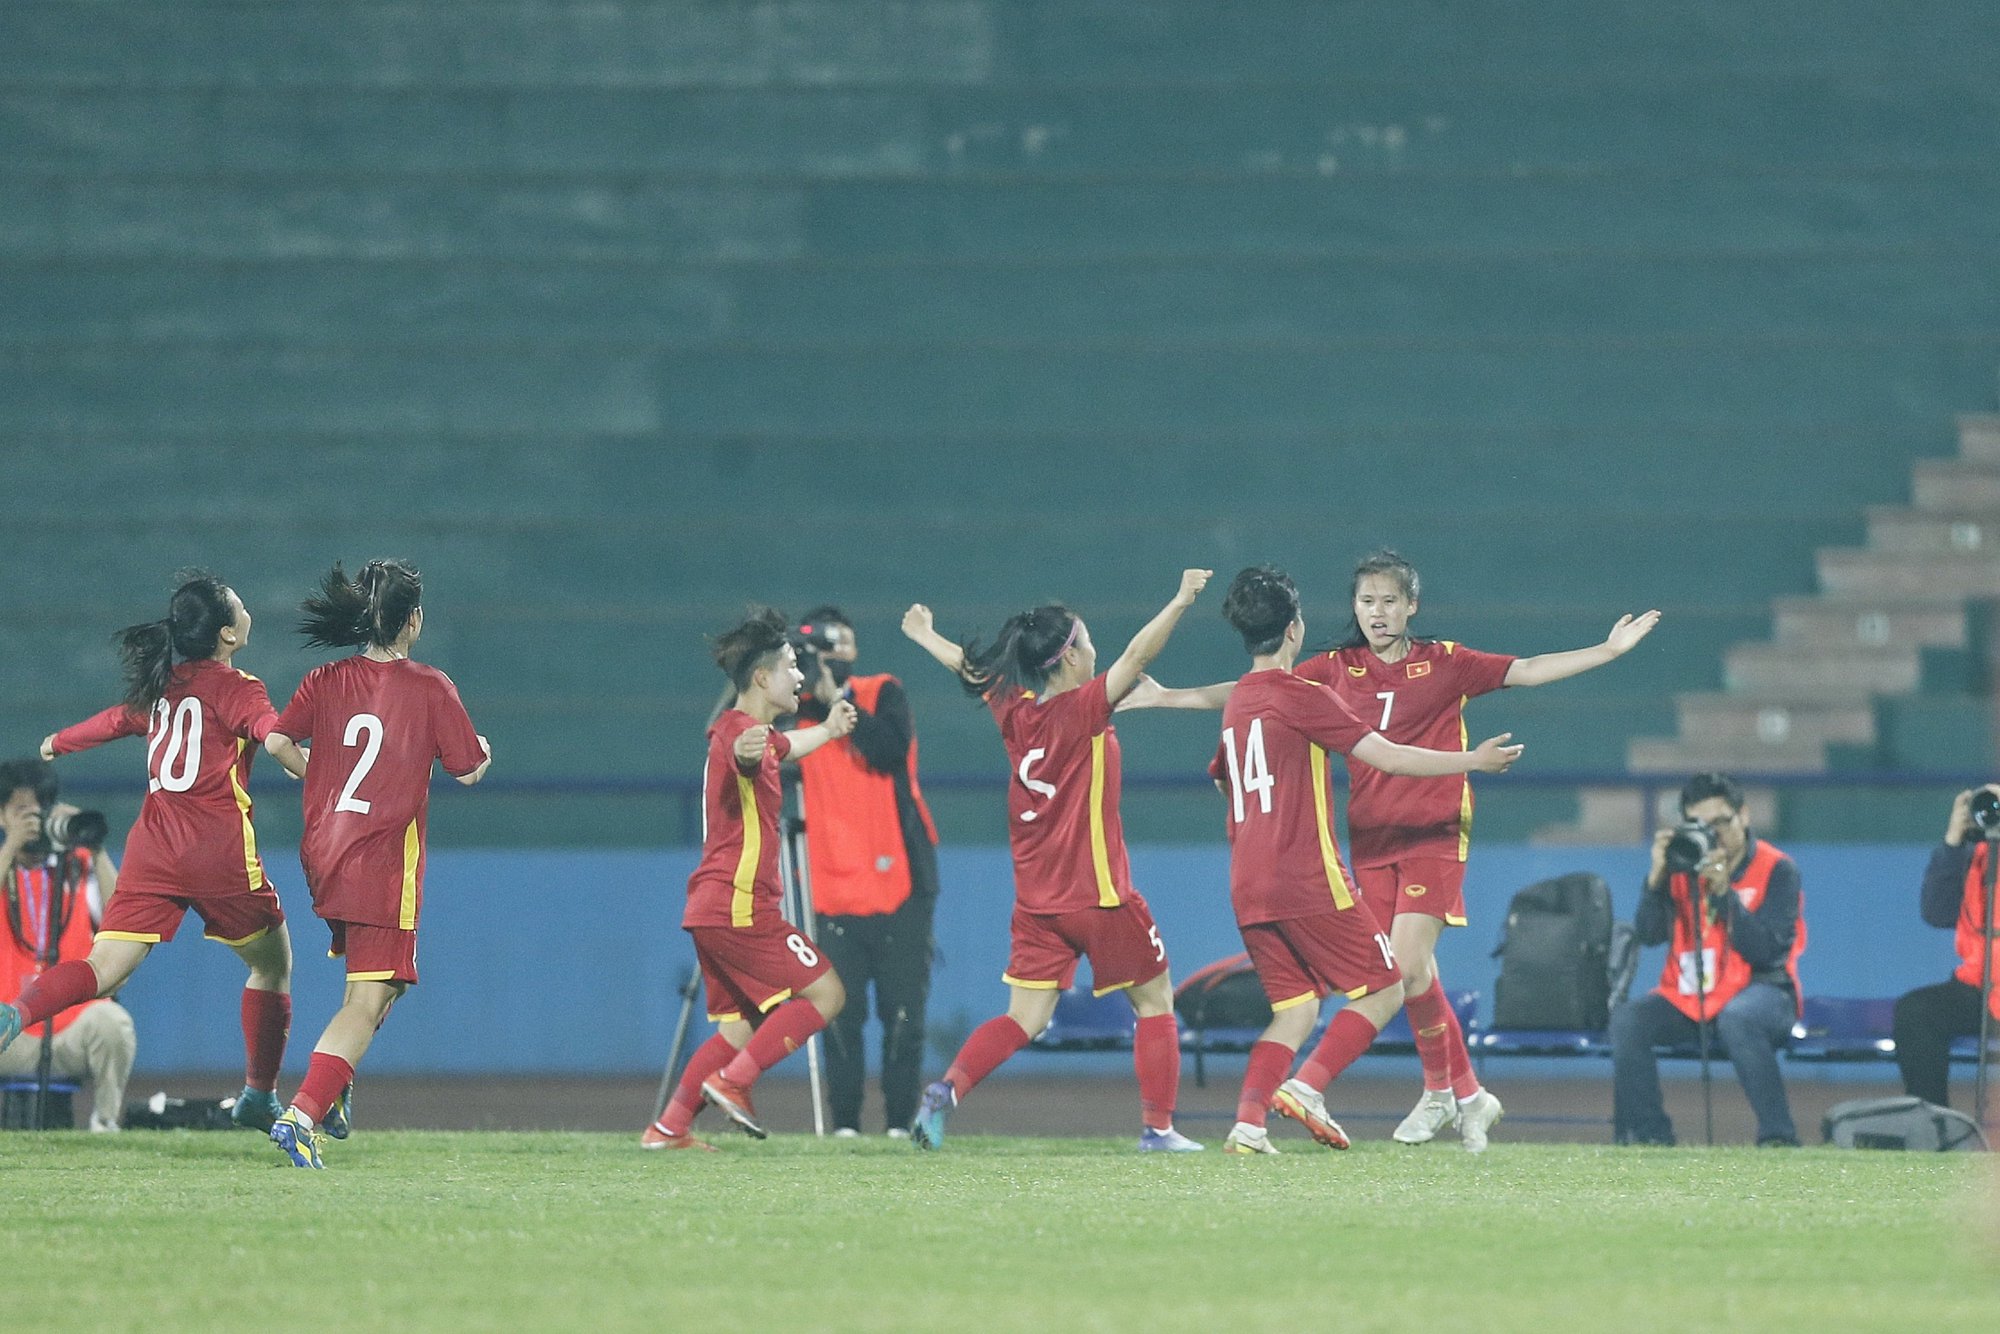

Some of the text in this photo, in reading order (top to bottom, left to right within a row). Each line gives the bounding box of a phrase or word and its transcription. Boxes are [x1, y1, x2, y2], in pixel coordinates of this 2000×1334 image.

[147, 696, 204, 795] 20
[1376, 691, 1395, 731] 7
[334, 713, 384, 815] 2
[1018, 747, 1057, 822] 5
[1222, 718, 1275, 823] 14
[786, 933, 819, 968] 8
[1148, 924, 1165, 962] 5
